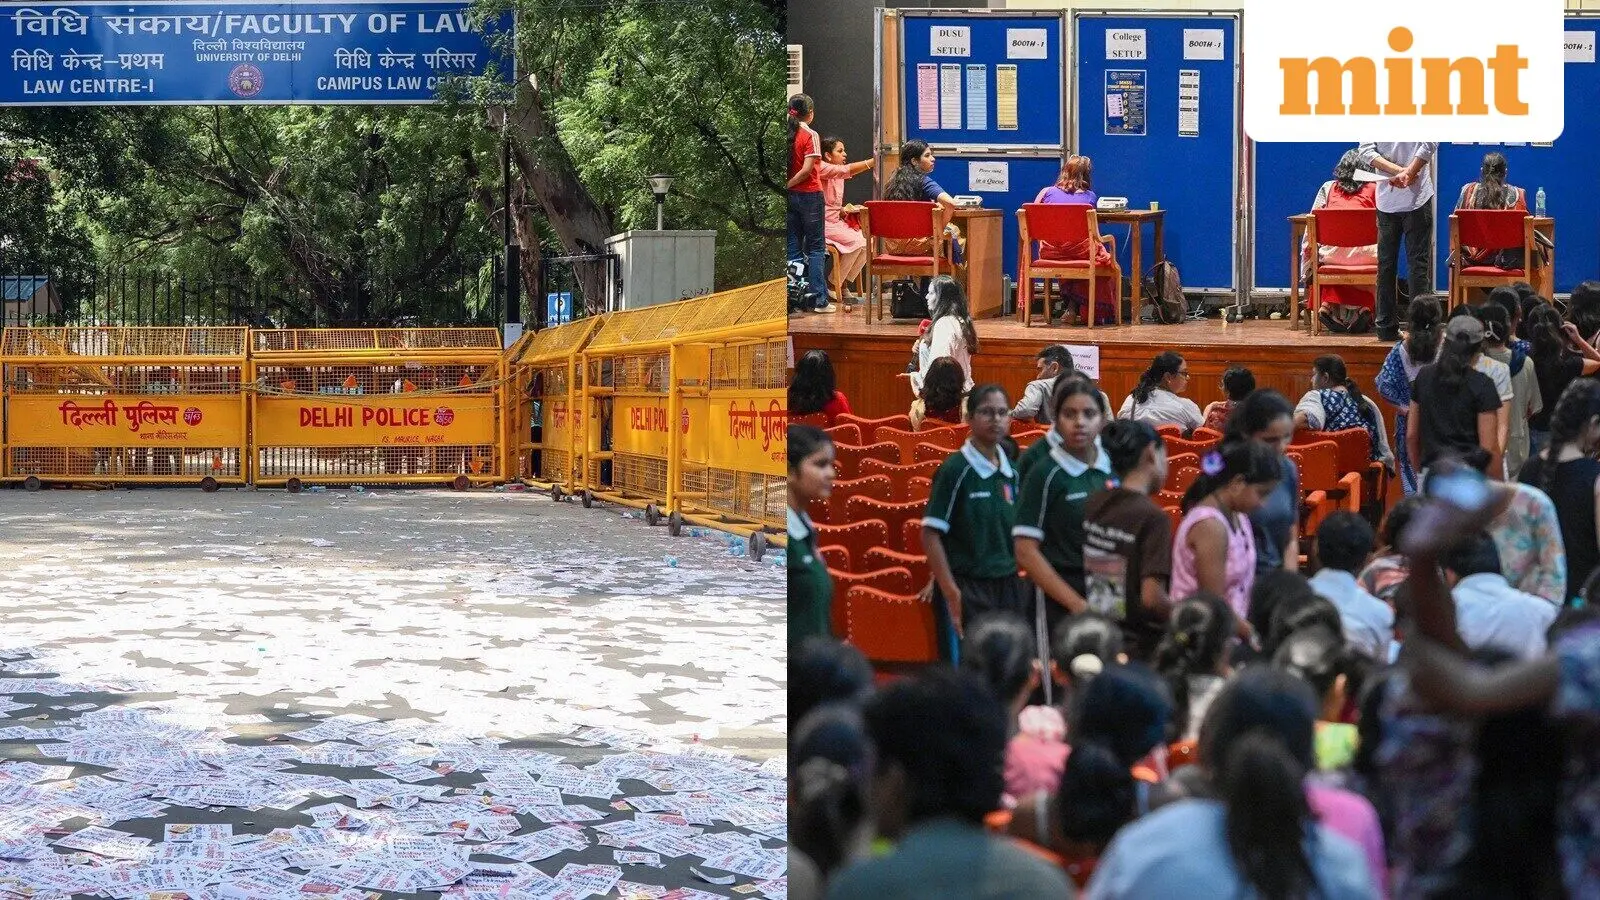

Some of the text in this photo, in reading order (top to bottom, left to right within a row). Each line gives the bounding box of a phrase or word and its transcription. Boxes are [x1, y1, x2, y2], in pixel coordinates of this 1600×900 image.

[11, 8, 88, 35] विधि
[368, 14, 406, 33] OF
[192, 38, 228, 51] दिल्ली
[1112, 31, 1142, 42] College
[196, 53, 302, 62] UNIVERSITY OF DELHI
[334, 47, 477, 69] विधि केन्द्र परिसर
[937, 47, 966, 55] SETUP
[1112, 50, 1142, 58] SETUP
[11, 49, 53, 71] विधि
[24, 79, 154, 94] LAW CENTRE-I
[317, 76, 383, 91] CAMPUS
[387, 76, 422, 90] LAW
[59, 400, 180, 432] दिल्ली पुलिस
[300, 407, 431, 427] DELHI POLICE
[631, 407, 651, 431] DELHI
[653, 407, 669, 432] POL
[728, 400, 758, 440] दिल्ली
